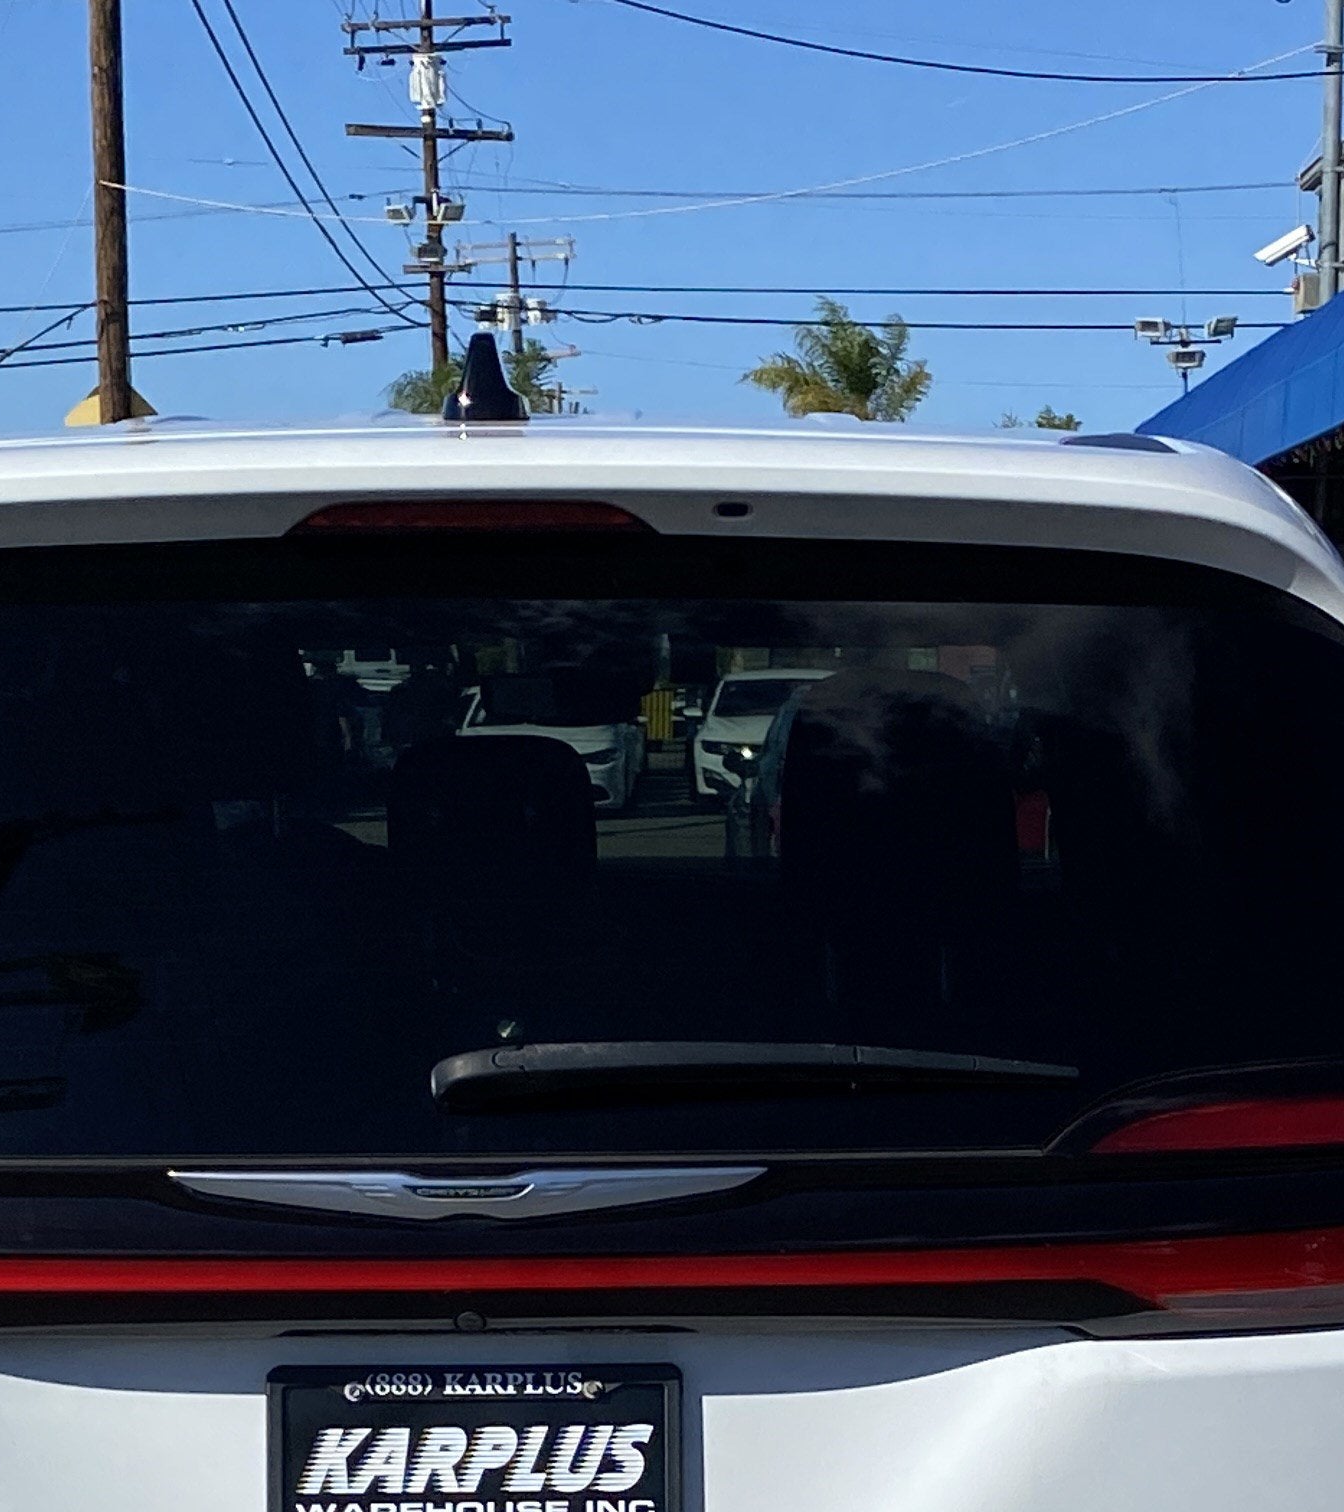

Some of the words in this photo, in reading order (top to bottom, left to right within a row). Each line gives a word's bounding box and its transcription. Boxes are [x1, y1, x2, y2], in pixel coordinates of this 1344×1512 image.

[365, 1372, 433, 1396] (888)
[443, 1371, 583, 1395] KARPLUS
[295, 1423, 654, 1494] KARPLUS
